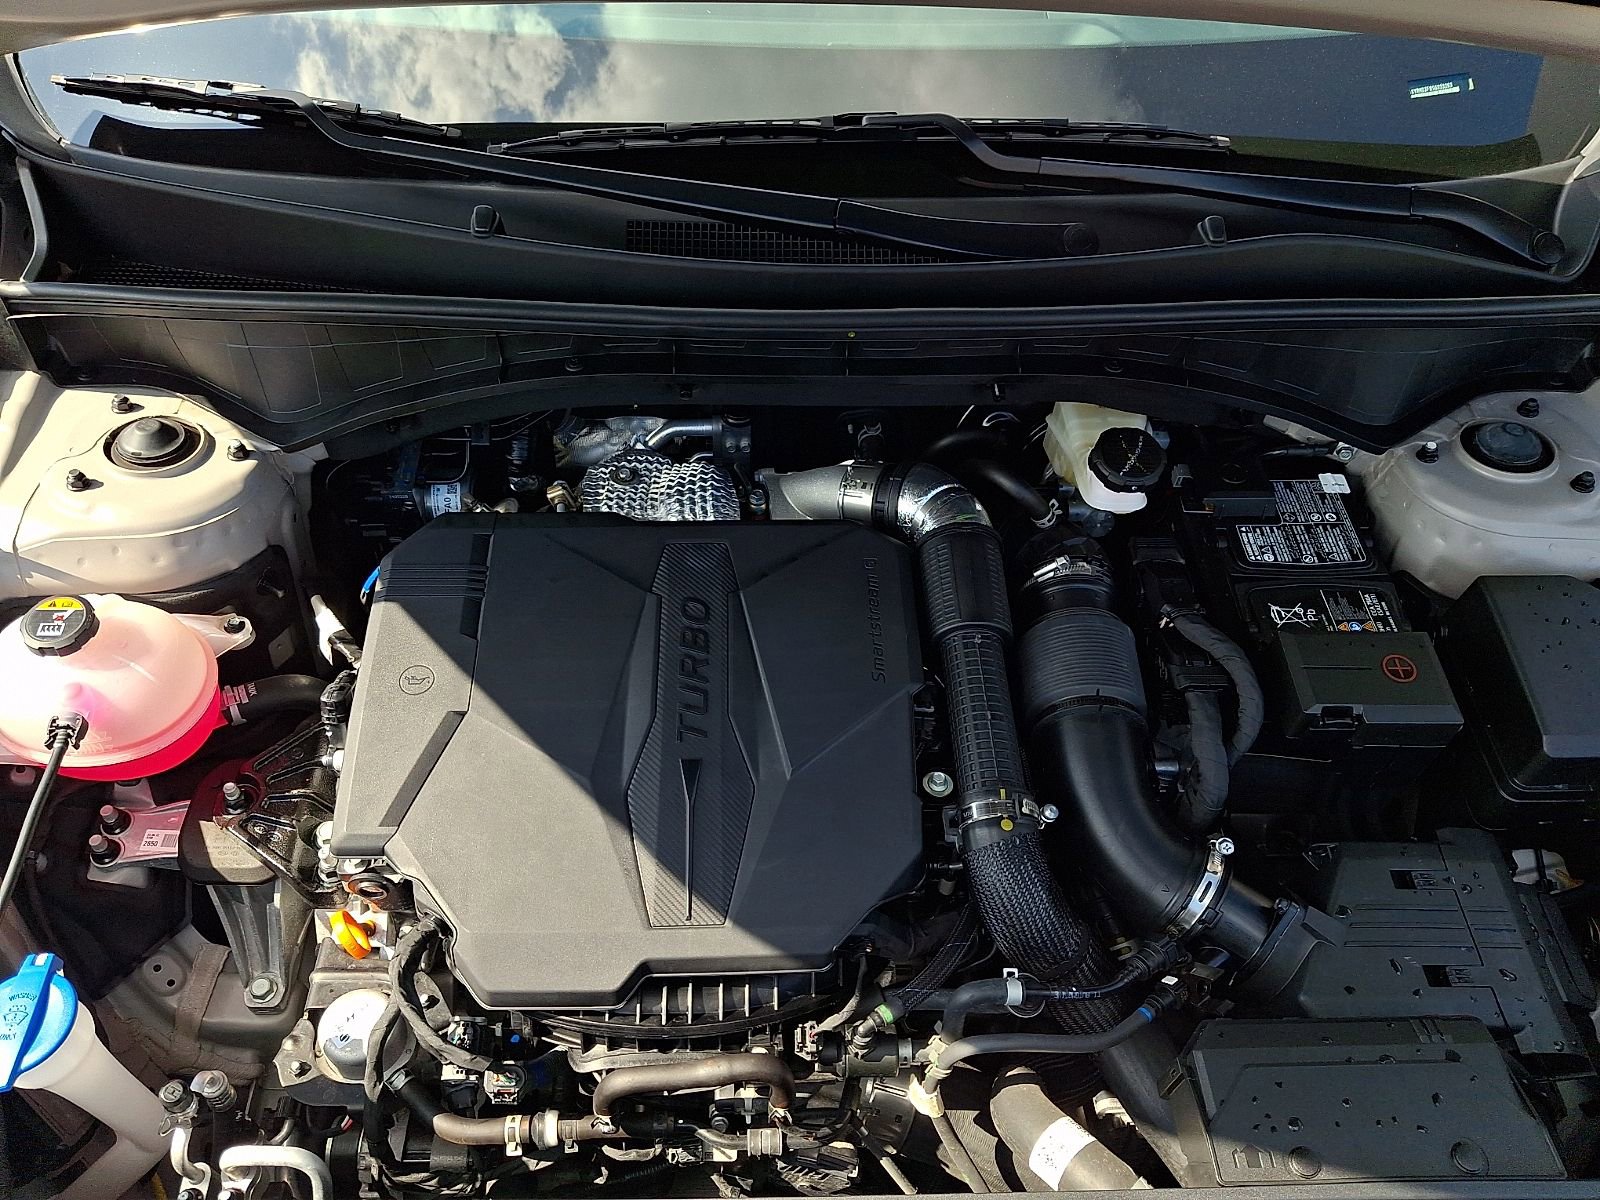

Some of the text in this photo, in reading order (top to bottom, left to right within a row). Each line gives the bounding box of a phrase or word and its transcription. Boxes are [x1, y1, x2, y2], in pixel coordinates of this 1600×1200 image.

[868, 574, 886, 685] Smartstream
[1306, 608, 1319, 621] Pb
[676, 599, 710, 743] TURBO
